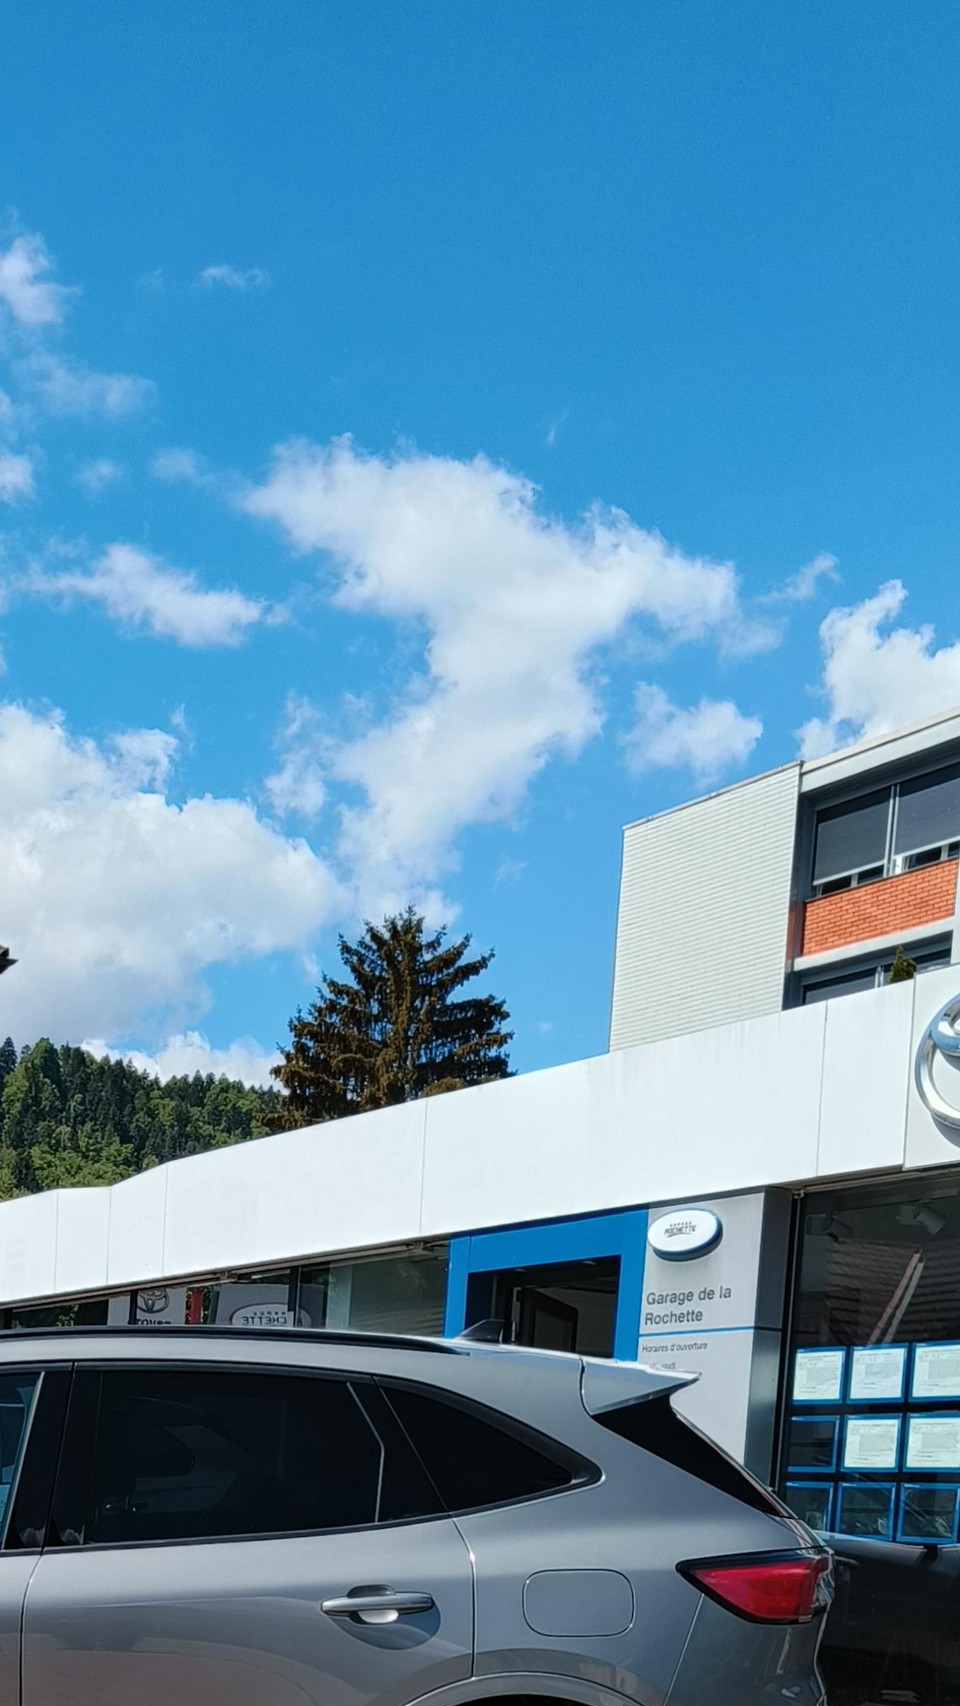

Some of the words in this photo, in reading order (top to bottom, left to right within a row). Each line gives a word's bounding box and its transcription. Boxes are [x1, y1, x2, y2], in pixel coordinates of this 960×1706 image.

[664, 1224, 697, 1235] ROCHETTE
[646, 1291, 694, 1306] Garage
[698, 1287, 716, 1301] de
[719, 1285, 732, 1299] la
[644, 1309, 704, 1326] Rochette
[641, 1344, 669, 1353] Horaires
[670, 1341, 708, 1352] d'ouverture
